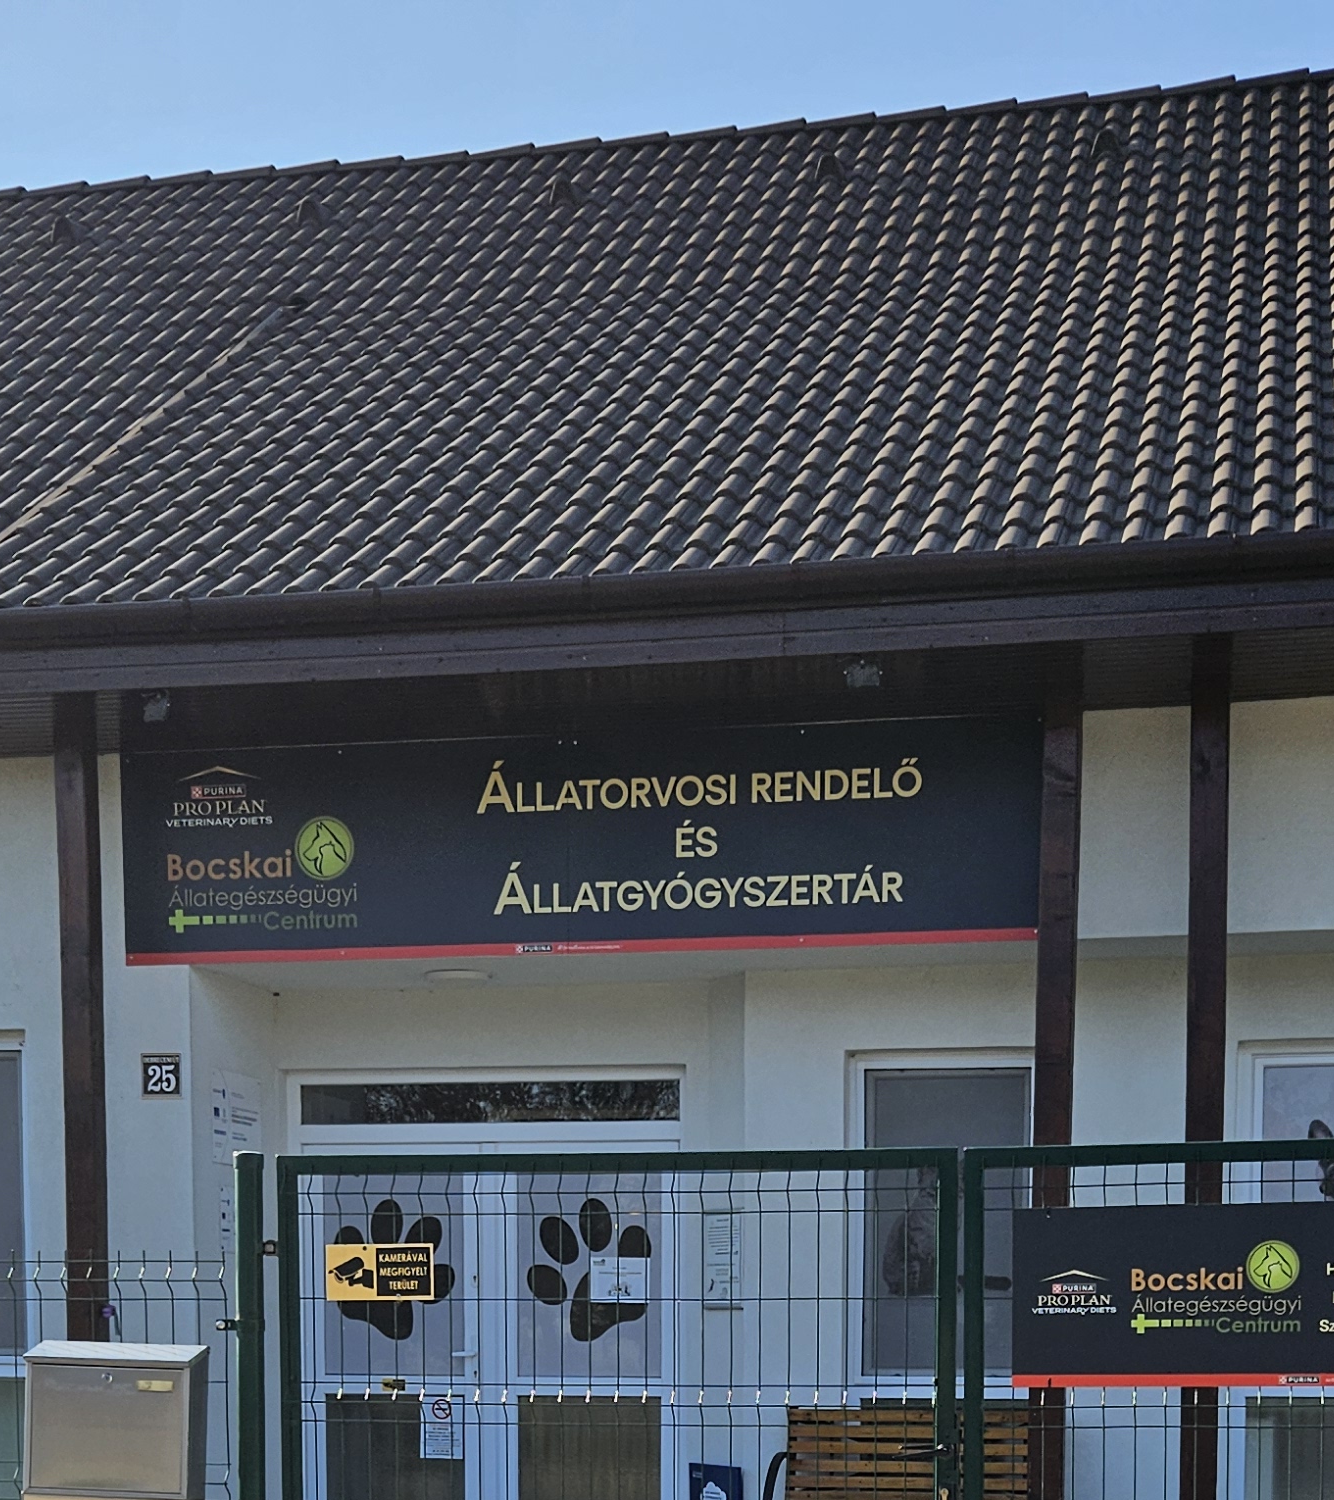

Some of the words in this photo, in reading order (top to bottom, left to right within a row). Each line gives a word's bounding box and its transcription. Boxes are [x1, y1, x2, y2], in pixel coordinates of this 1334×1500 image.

[203, 786, 244, 796] PURINA
[476, 760, 736, 814] ÁLLATORVOSI
[751, 757, 923, 803] RENDELŐ
[173, 801, 212, 817] PRO
[216, 799, 266, 816] PLAN
[166, 817, 239, 828] VETERINARY
[240, 815, 273, 825] DIETS
[675, 819, 719, 859] ÉS
[167, 849, 293, 881] Bocskai
[168, 882, 358, 911] Állategészségügyi
[493, 861, 904, 915] ÁLLATGYÓGYSZERTÁR
[263, 911, 358, 931] Centrum
[147, 1064, 177, 1092] 25
[378, 1251, 428, 1263] KAMERÁVAL
[379, 1267, 428, 1277] MEGFIGYELT
[1130, 1267, 1244, 1292] Bocskai
[388, 1279, 419, 1290] TERÜLET
[1062, 1284, 1094, 1293] PURINA
[1037, 1295, 1069, 1307] PRO
[1072, 1294, 1111, 1307] PLAN
[1130, 1294, 1302, 1317] Állategészségügyi
[1031, 1306, 1089, 1316] VETERINARY
[1090, 1306, 1117, 1314] DIETS
[1215, 1316, 1301, 1334] Centrum
[1288, 1376, 1319, 1384] PURINA
